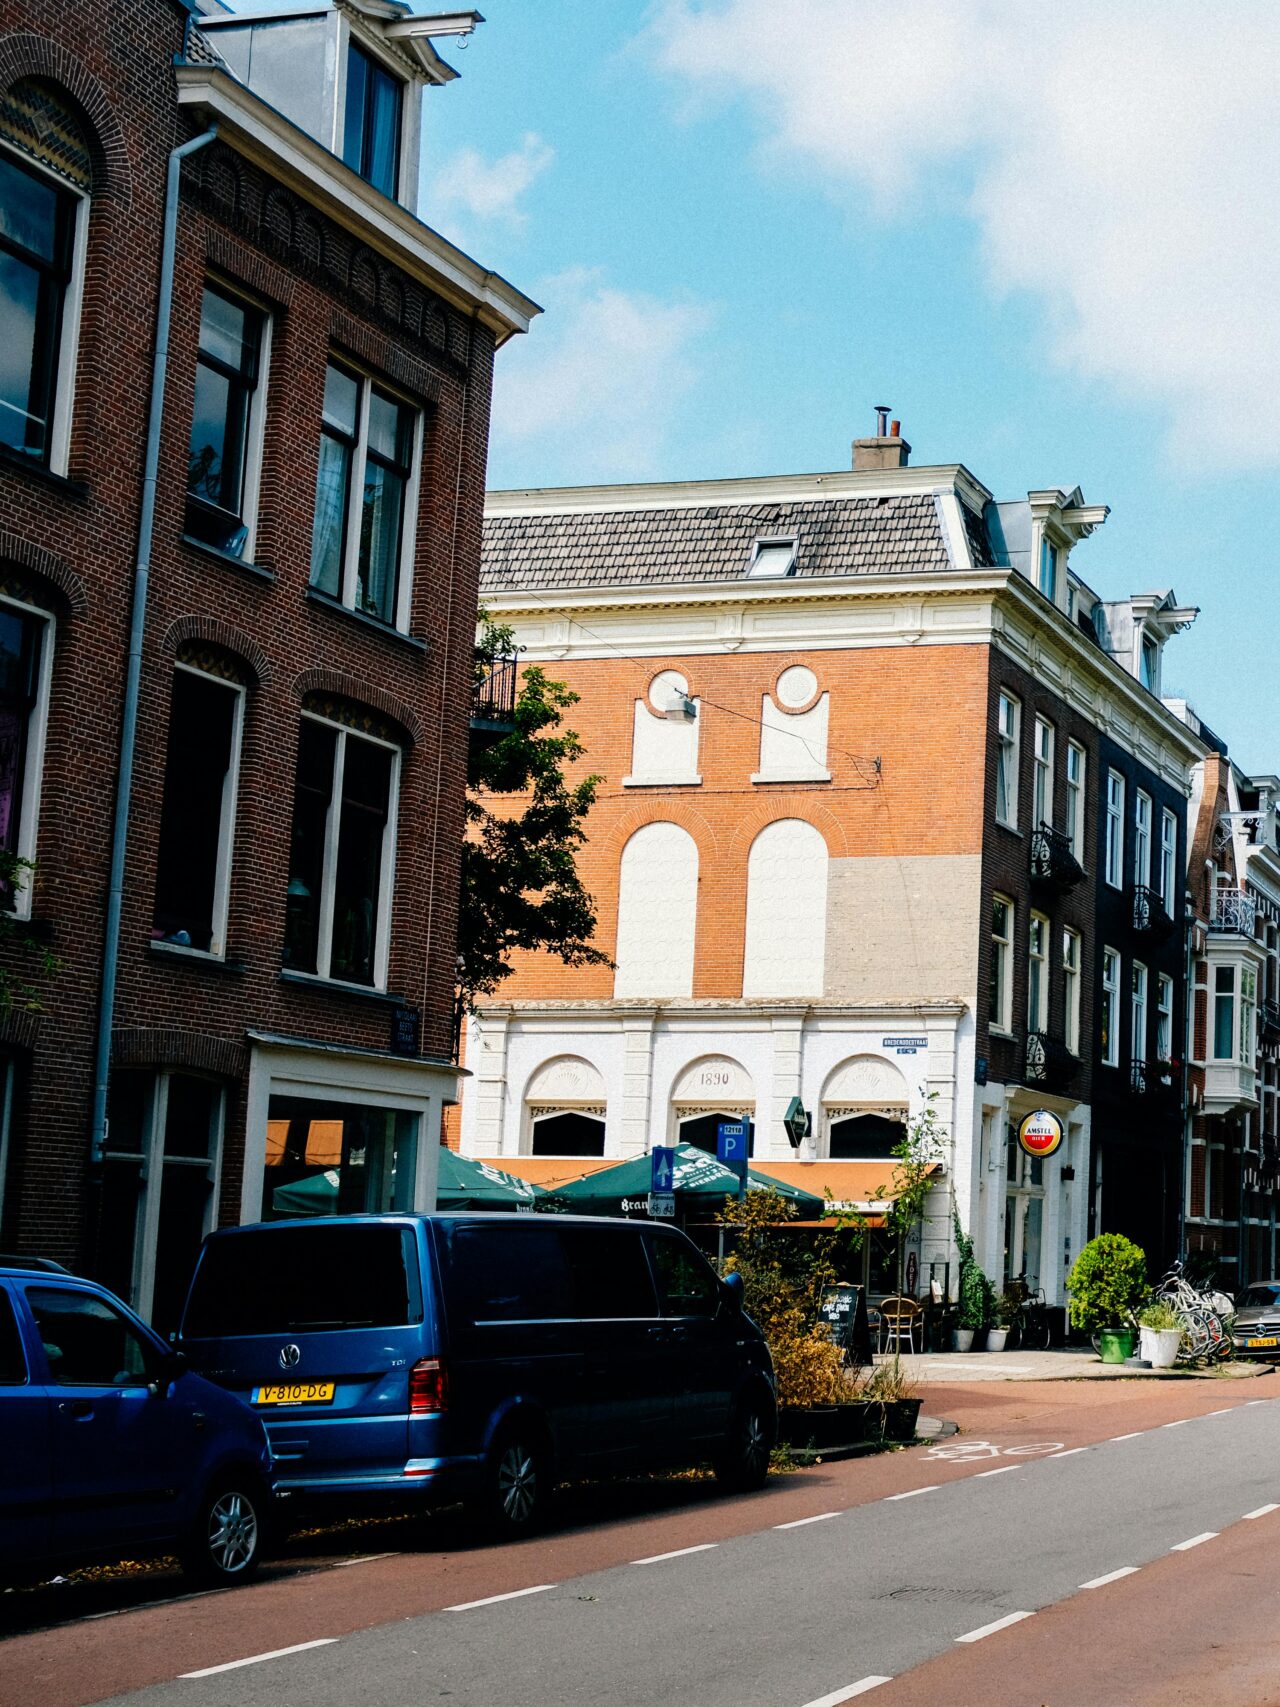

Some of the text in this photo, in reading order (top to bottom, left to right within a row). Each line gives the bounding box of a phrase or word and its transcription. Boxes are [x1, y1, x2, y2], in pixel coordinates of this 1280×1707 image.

[701, 1072, 729, 1086] 1890
[725, 1138, 736, 1158] P
[621, 1198, 649, 1212] Bran
[264, 1384, 328, 1400] V-810-DG
